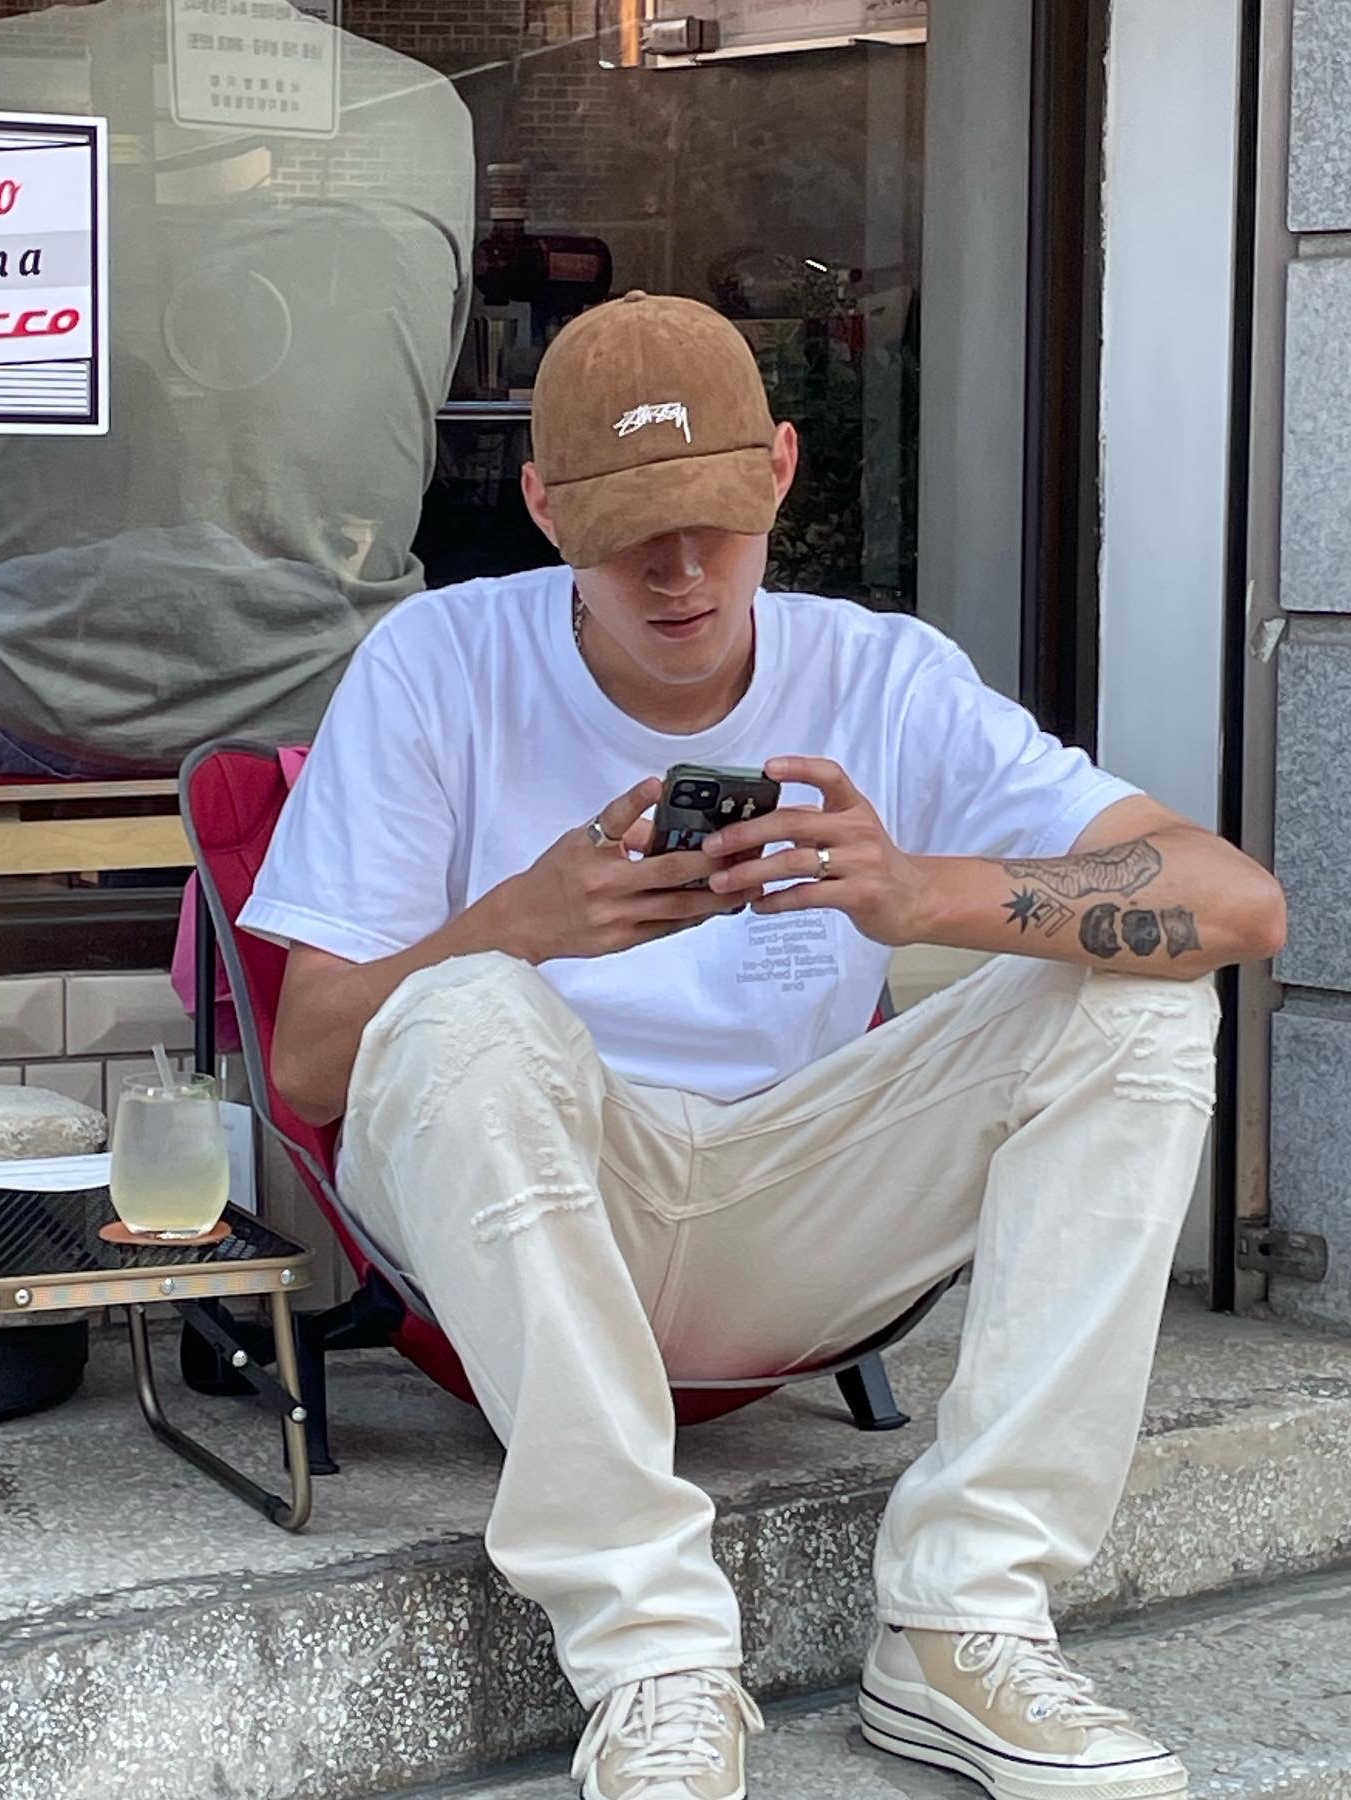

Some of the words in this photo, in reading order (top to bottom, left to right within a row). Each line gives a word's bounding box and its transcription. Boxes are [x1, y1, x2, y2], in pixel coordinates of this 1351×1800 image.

[749, 930, 827, 946] hand-painted
[736, 968, 791, 984] bleached
[781, 980, 804, 992] and
